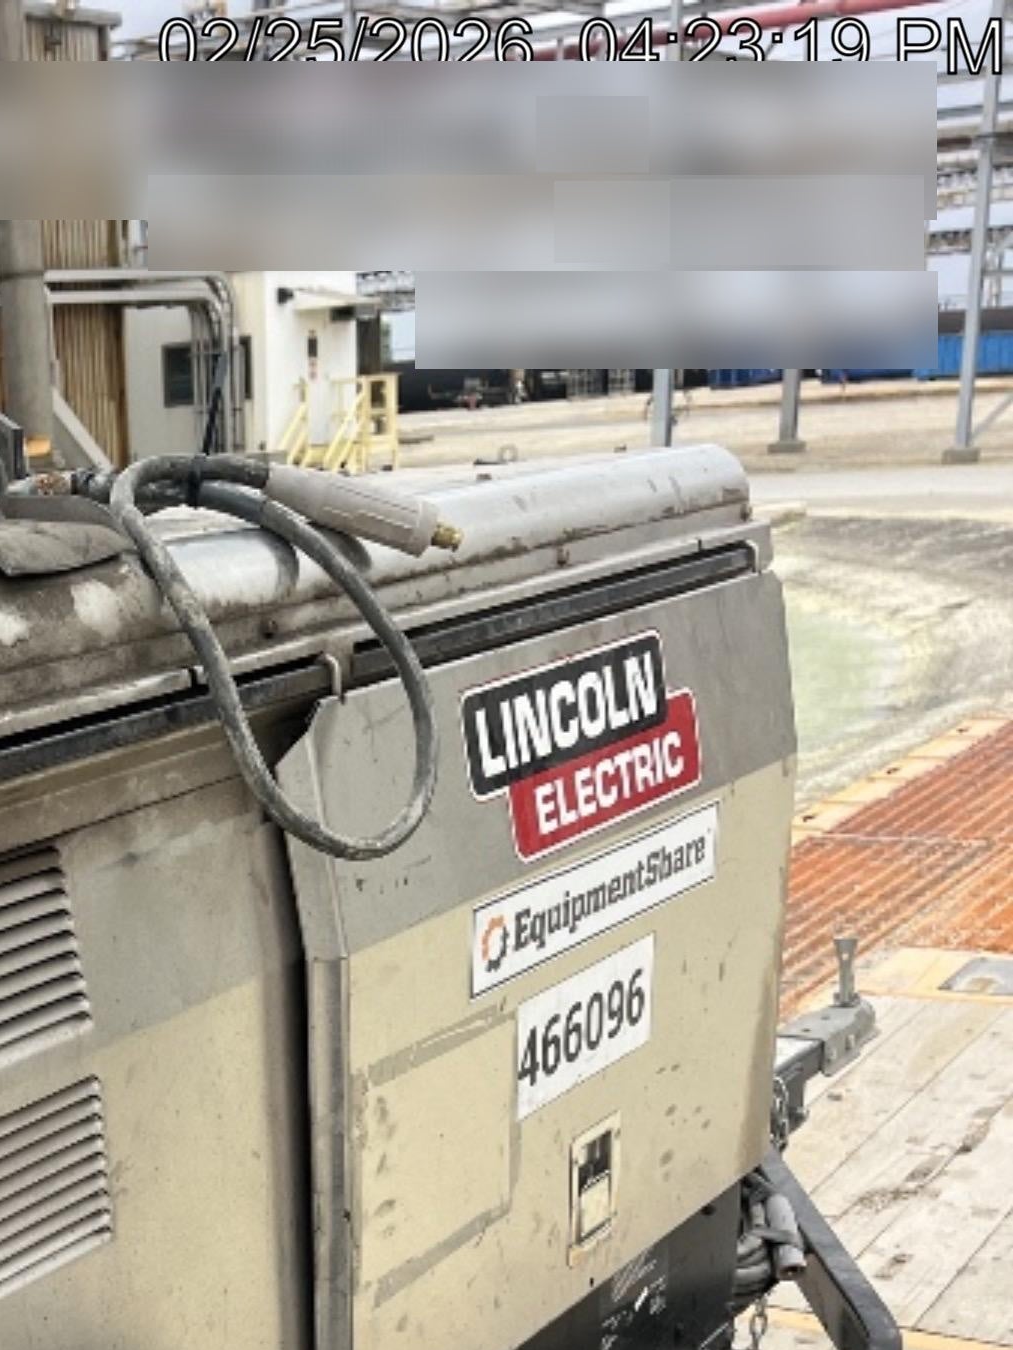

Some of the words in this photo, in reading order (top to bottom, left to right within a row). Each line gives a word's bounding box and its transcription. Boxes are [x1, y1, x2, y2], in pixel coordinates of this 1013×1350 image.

[475, 650, 658, 778] LINCOLN
[533, 731, 685, 835] ELECTRIC
[513, 835, 707, 952] EquipmentShare
[517, 968, 645, 1087] 466096
